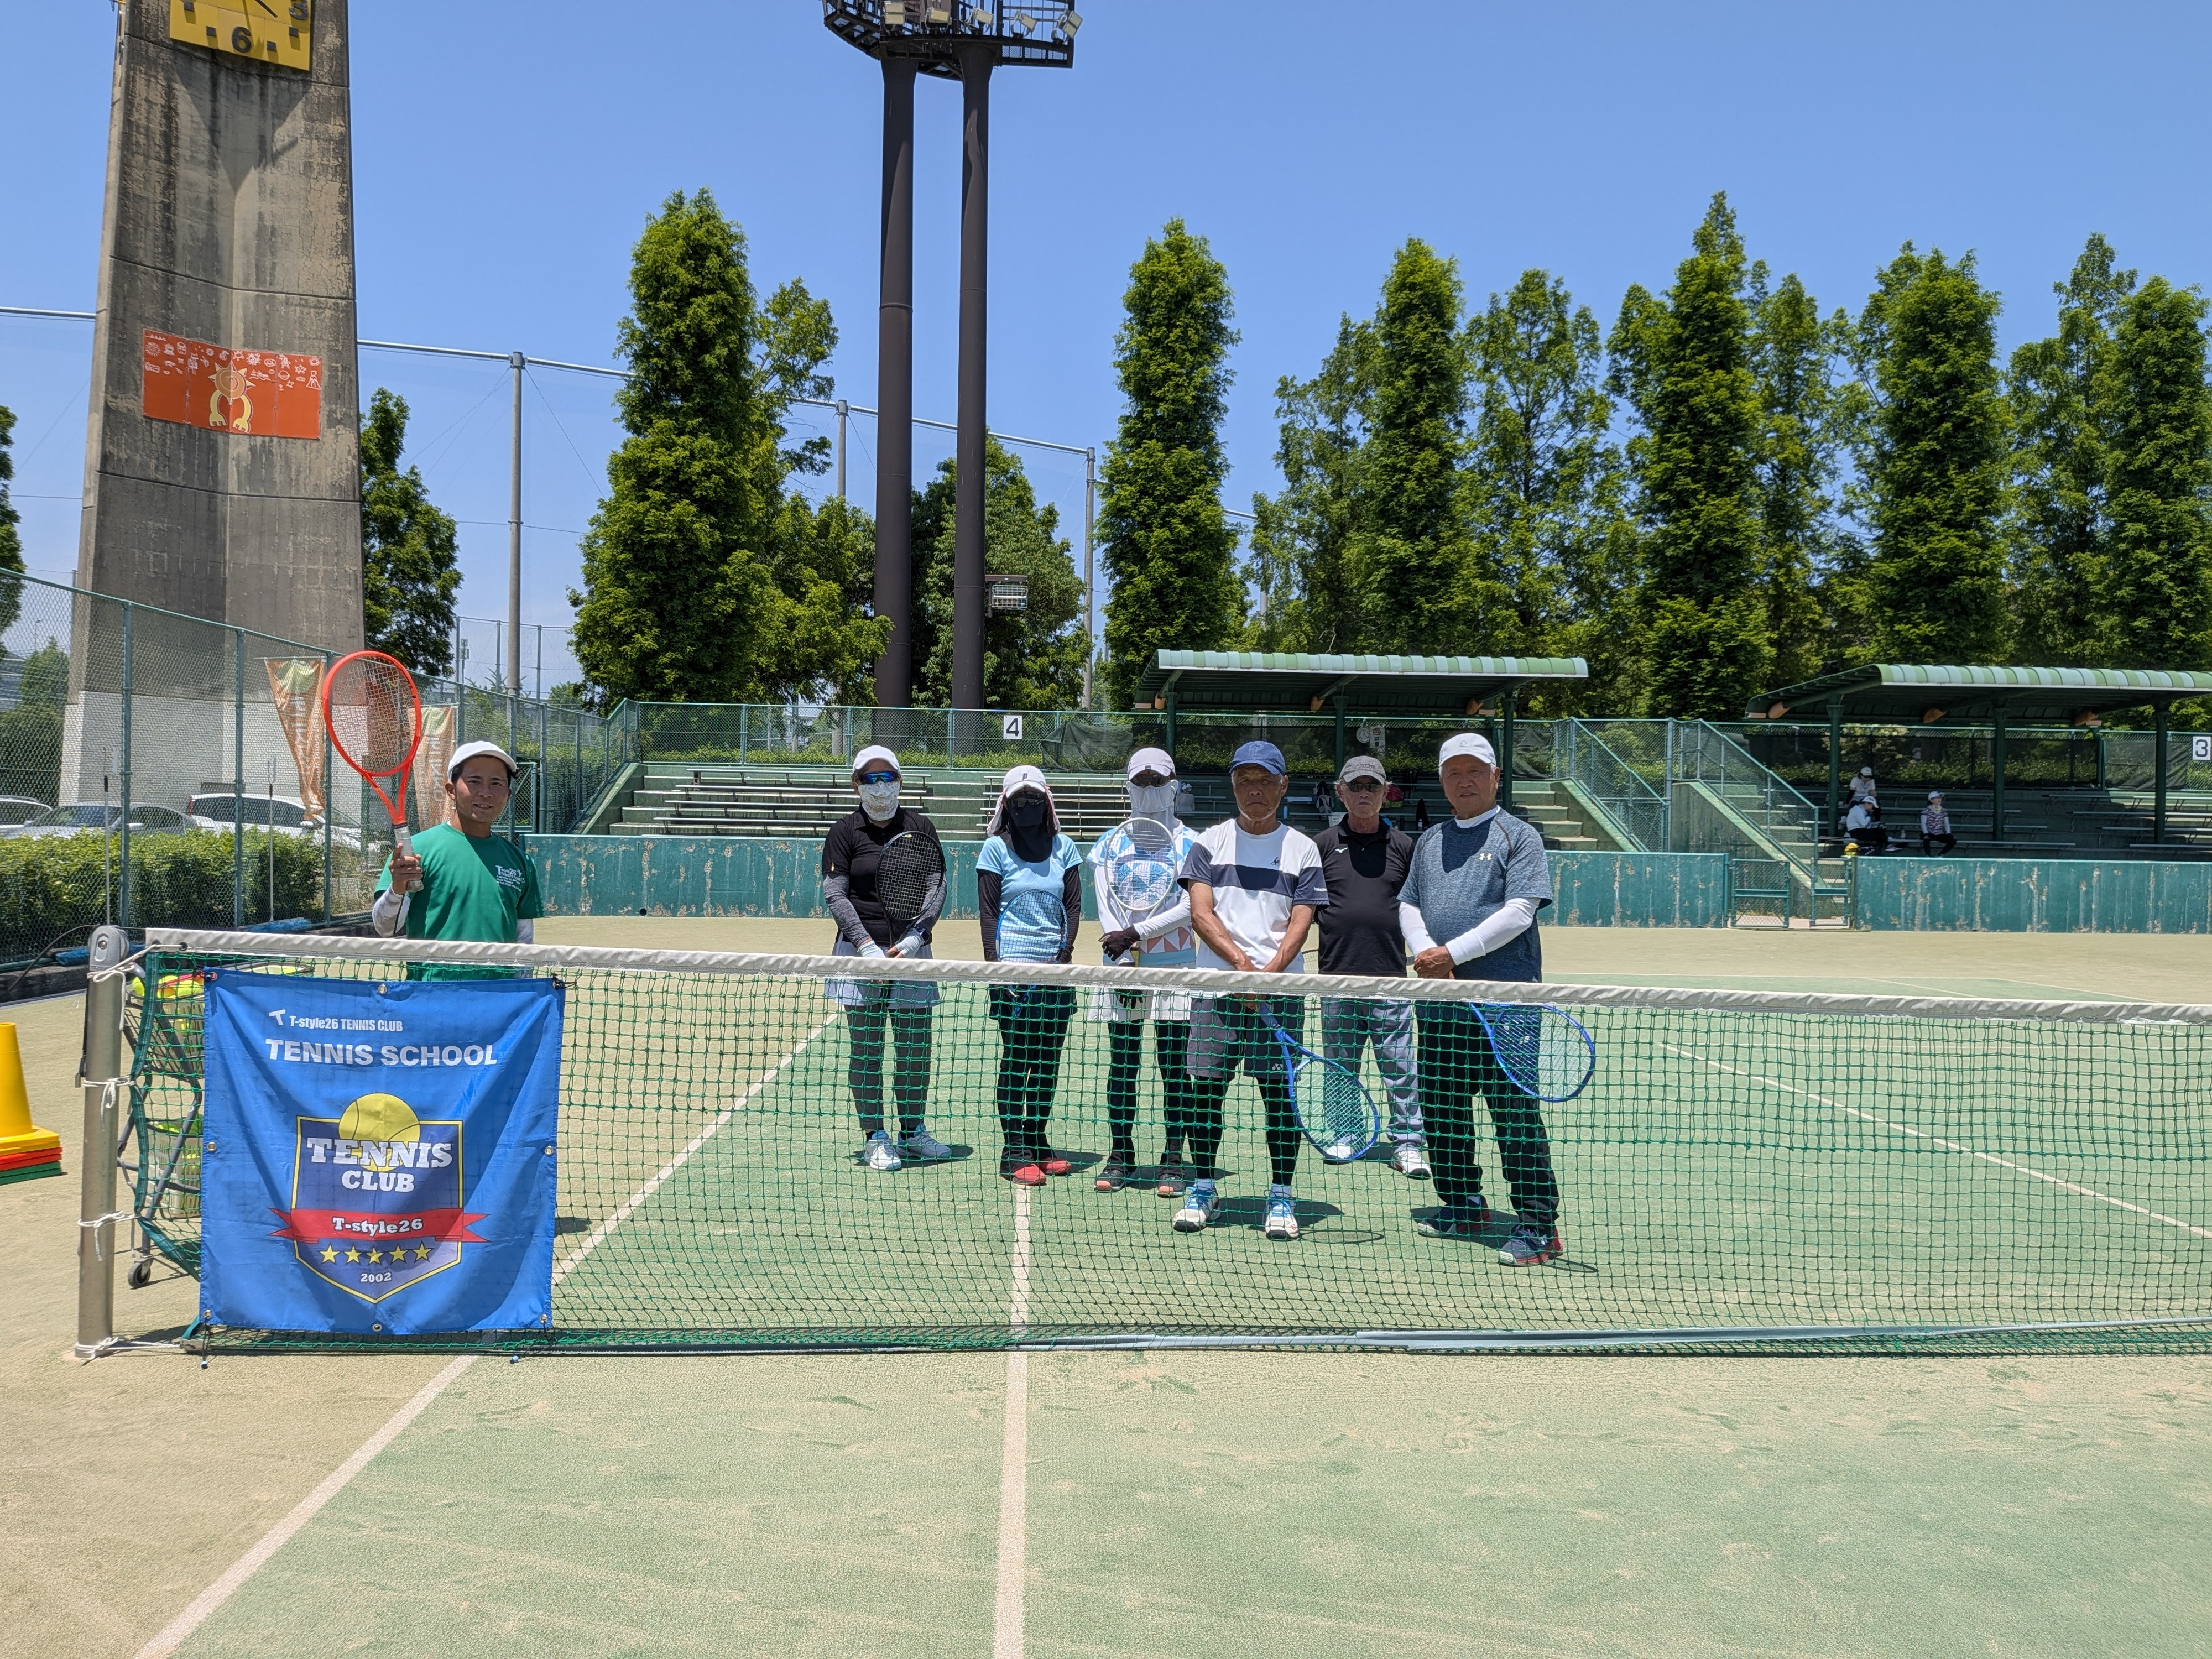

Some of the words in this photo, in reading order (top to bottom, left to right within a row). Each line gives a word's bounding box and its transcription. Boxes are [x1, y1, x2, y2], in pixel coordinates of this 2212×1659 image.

[232, 27, 252, 53] 6
[1006, 718, 1019, 737] 4
[2195, 739, 2208, 757] 3
[290, 1016, 339, 1030] T-style26
[341, 1019, 375, 1031] TENNIS
[378, 1020, 403, 1032] CLUB
[265, 1039, 374, 1065] TENNIS
[380, 1045, 498, 1066] SCHOOL
[306, 1138, 452, 1168] TENNIS
[342, 1170, 414, 1192] CLUB
[333, 1217, 423, 1237] T-style26
[360, 1272, 392, 1282] 2002
